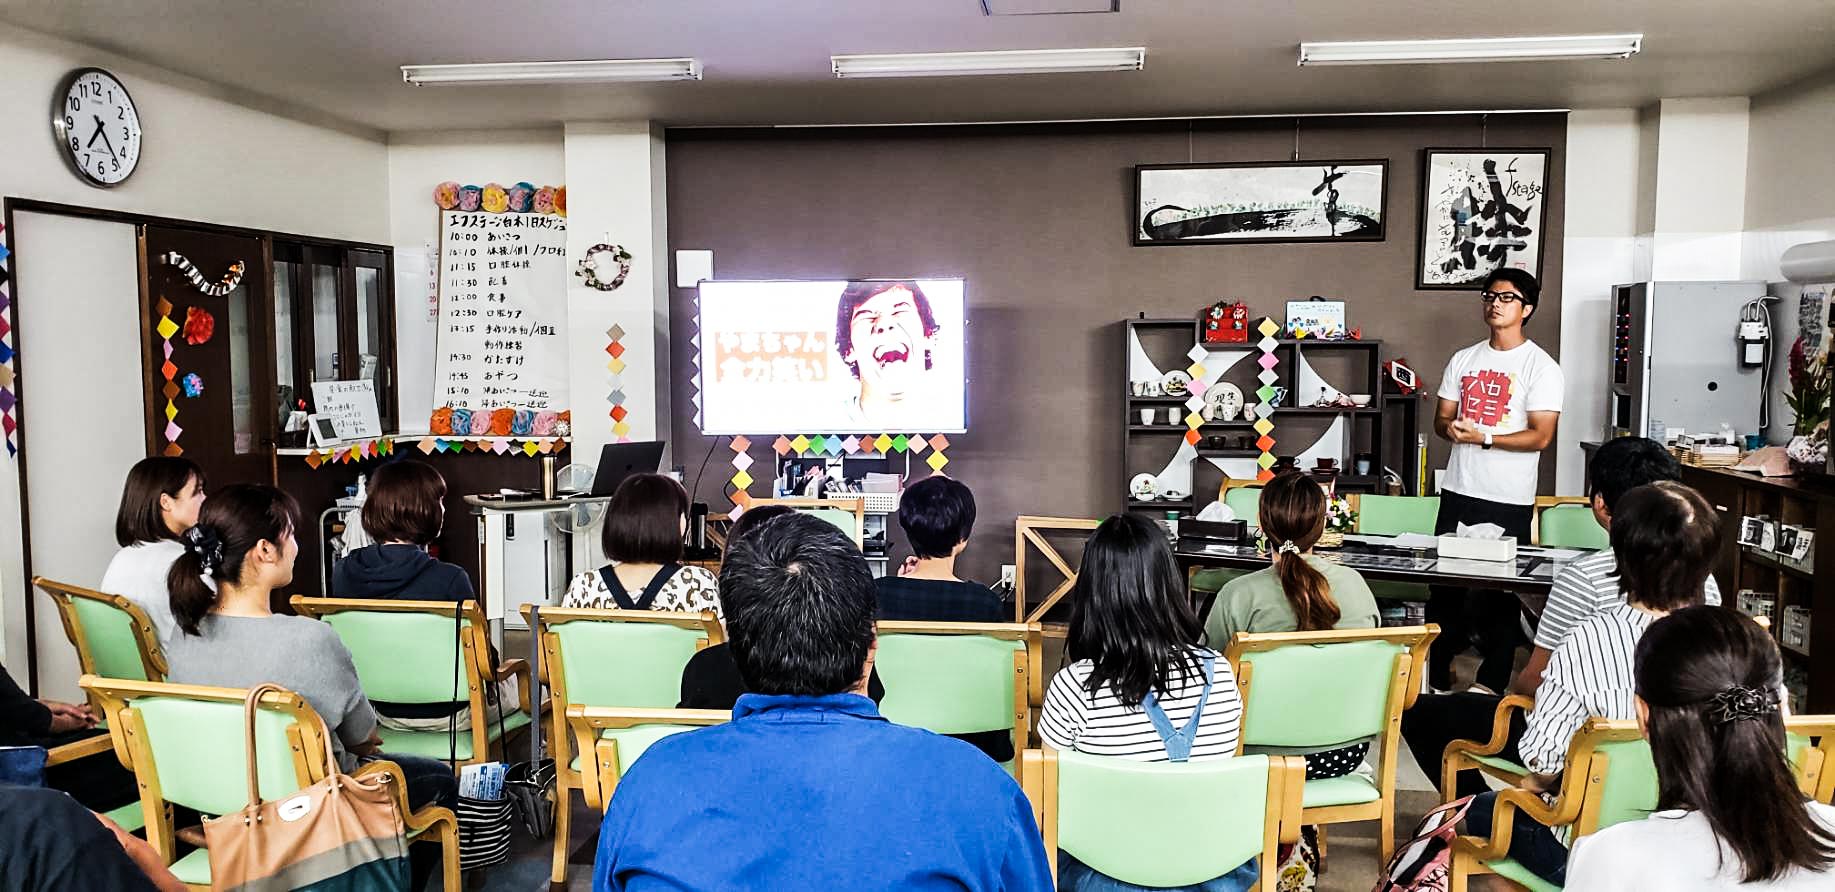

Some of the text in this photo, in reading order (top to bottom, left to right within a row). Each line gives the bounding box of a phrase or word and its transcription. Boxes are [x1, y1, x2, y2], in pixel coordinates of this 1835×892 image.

[79, 83, 88, 98] 11
[91, 81, 102, 97] 12
[69, 96, 81, 112] 10
[108, 90, 112, 104] 1
[117, 106, 124, 120] 2
[66, 115, 74, 130] 9
[122, 127, 129, 141] 3
[72, 136, 79, 152] 8
[119, 145, 127, 159] 4
[83, 153, 90, 167] 7
[111, 158, 119, 172] 5
[97, 160, 105, 175] 6
[450, 232, 478, 242] 10:00
[450, 263, 477, 272] 11:15
[450, 279, 478, 287] 11:30
[450, 309, 478, 317] 12:30
[449, 353, 472, 362] 14:30
